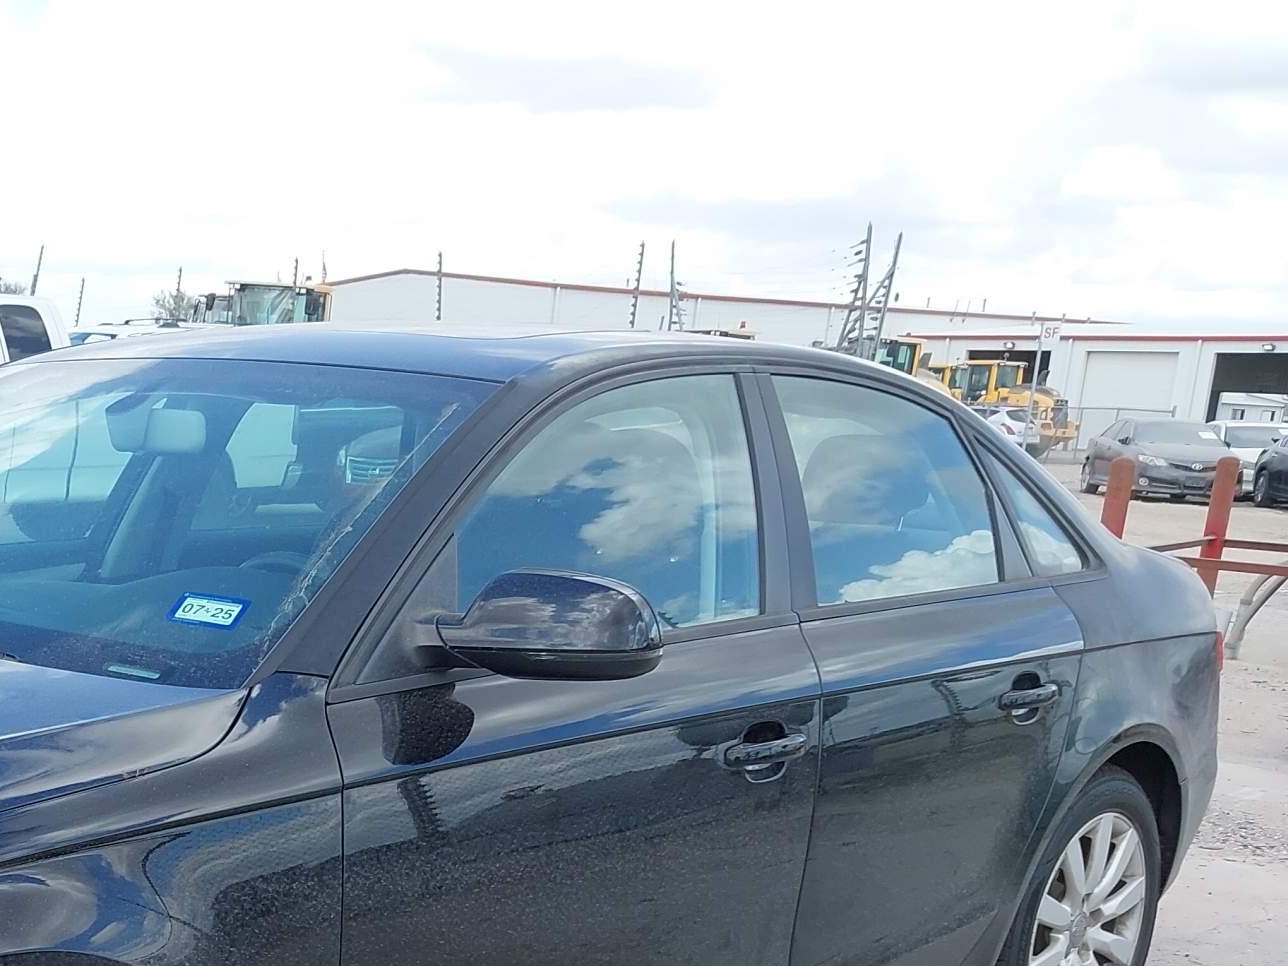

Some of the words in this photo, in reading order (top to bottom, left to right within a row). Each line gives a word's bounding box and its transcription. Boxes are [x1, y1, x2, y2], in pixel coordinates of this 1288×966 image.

[1044, 327, 1060, 338] SF
[181, 603, 206, 615] 07
[210, 607, 236, 620] 25
